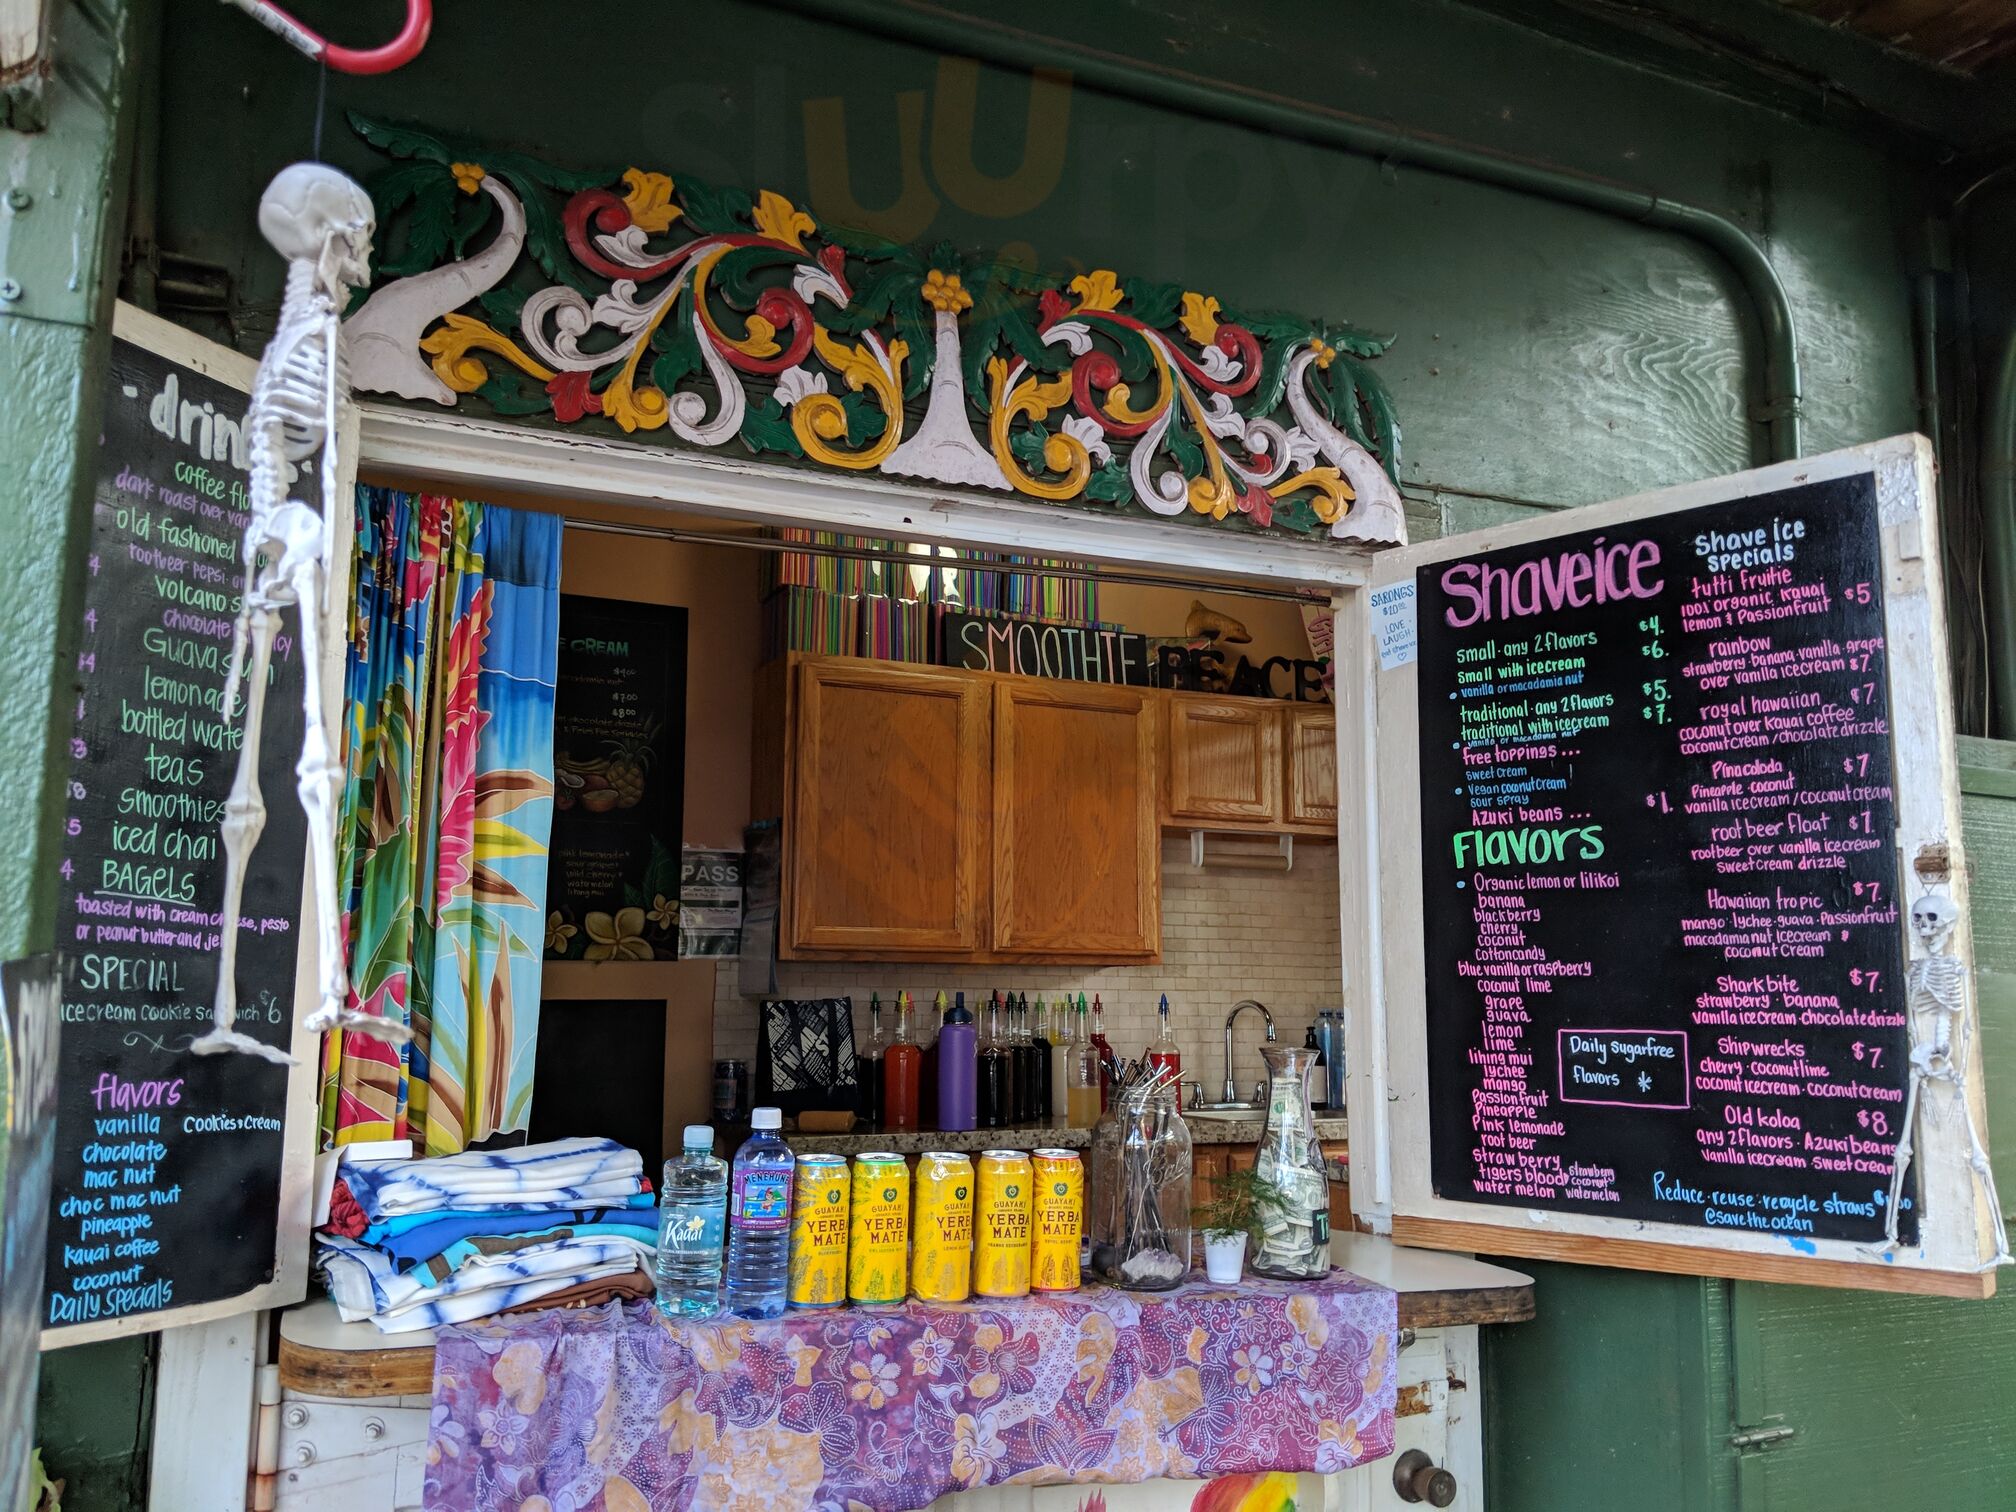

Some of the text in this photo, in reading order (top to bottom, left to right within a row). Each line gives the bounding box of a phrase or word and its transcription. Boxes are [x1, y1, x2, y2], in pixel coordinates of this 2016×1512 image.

[174, 460, 225, 501] coffee
[115, 464, 155, 498] dark
[158, 484, 199, 515] roast
[199, 496, 224, 521] over
[115, 509, 151, 542] old
[156, 517, 238, 561] fashioned
[1772, 517, 1806, 542] ice
[154, 574, 228, 613] volcano
[1371, 584, 1415, 608] SARONGS
[1690, 575, 1734, 599] tutti
[1712, 588, 1775, 612] organic
[163, 606, 232, 640] chocolate
[1384, 619, 1406, 635] LOVE
[1682, 615, 1723, 633] lemon
[143, 627, 219, 671] Guava
[1503, 640, 1529, 659] any
[1681, 636, 1885, 678] strawberry banana vanilla grape
[1708, 635, 1771, 659] rainbow
[1497, 662, 1524, 680] with
[1699, 666, 1779, 692] over vanilla
[1461, 669, 1585, 698] vanilla macadamia nut
[1459, 699, 1558, 724] traditional any
[1698, 689, 1822, 722] royal hawaiian
[1805, 702, 1856, 725] coffee
[121, 698, 187, 746] bottled
[1460, 718, 1554, 741] traditional with
[144, 743, 205, 787] teas
[1462, 746, 1493, 767] free
[1465, 766, 1495, 782] sweet
[1749, 770, 1796, 794] coconut
[1470, 794, 1493, 809] sour
[1518, 805, 1564, 822] beans
[1710, 817, 1743, 843] root
[1743, 816, 1785, 839] beer
[112, 820, 217, 862] iced chai
[1452, 825, 1606, 869] Flavors
[1746, 837, 1822, 857] over vanilla
[681, 862, 740, 884] PASS
[1797, 854, 1847, 872] drizzle
[1473, 871, 1577, 893] Organic lemon or
[1477, 892, 1526, 910] banana
[1706, 887, 1771, 911] Hawaiian
[75, 894, 208, 927] toasted with cream
[1472, 906, 1541, 924] blackberry
[1480, 921, 1520, 937] cherry
[1680, 912, 1815, 932] mango lychee guava
[75, 923, 141, 948] or peanut
[1477, 931, 1527, 947] coconut
[1683, 928, 1774, 947] macadamia nut
[79, 953, 186, 993] SPECIAL
[1457, 959, 1593, 978] blue vanilla raspberry
[1477, 976, 1553, 994] coconut lime
[140, 1001, 192, 1022] cookie
[1484, 994, 1525, 1011] grape
[1695, 992, 1841, 1010] strawberry banana
[1486, 1009, 1533, 1023] guava
[1690, 1009, 1738, 1026] vanilla
[1481, 1019, 1524, 1038] lemon
[1483, 1036, 1518, 1052] lime
[1569, 1036, 1608, 1065] Daily
[1468, 1046, 1534, 1067] lihing mui
[1699, 1056, 1744, 1077] cherry
[1483, 1064, 1528, 1080] lychee
[90, 1072, 185, 1113] flavors
[1482, 1077, 1527, 1093] mango
[94, 1114, 162, 1137] vanilla
[1723, 1104, 1754, 1128] Old
[1508, 1118, 1566, 1137] lemonade
[1695, 1128, 1726, 1147] any
[82, 1139, 168, 1165] chocolate
[1480, 1133, 1537, 1151] root beer
[1700, 1147, 1746, 1166] vanilla
[83, 1163, 157, 1189] mac nut
[1478, 1162, 1523, 1183] tigers
[59, 1183, 183, 1219] choc mac nut
[1652, 1169, 1706, 1205] Reduce
[1711, 1189, 1757, 1208] reuse
[1761, 1193, 1820, 1220] recycle
[1822, 1190, 1877, 1218] straws
[986, 1213, 1031, 1226] YERBA
[1036, 1209, 1080, 1223] YERBA
[81, 1213, 154, 1242] pineapple
[870, 1230, 904, 1245] MATE
[942, 1228, 973, 1242] MATE
[992, 1225, 1027, 1239] MATE
[1042, 1223, 1077, 1236] MATE
[813, 1232, 847, 1248] MATE
[63, 1236, 161, 1269] kauai coffee
[72, 1262, 145, 1293] coconut
[49, 1292, 101, 1324] Daily
